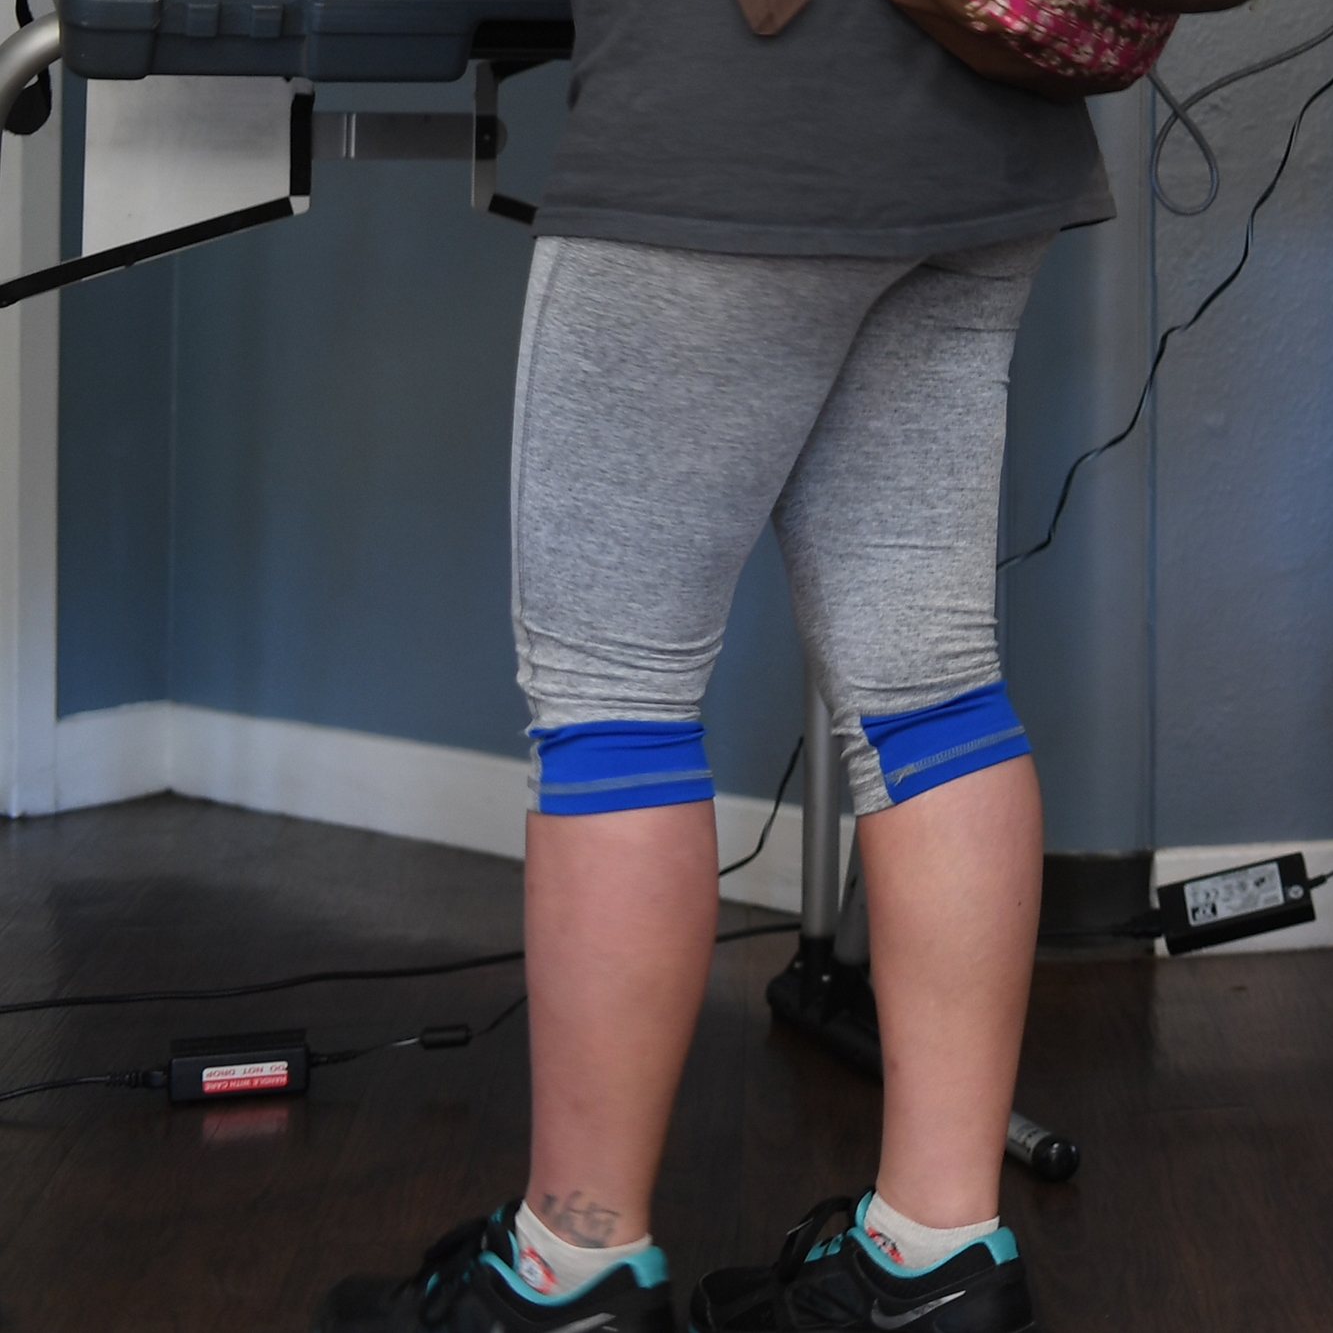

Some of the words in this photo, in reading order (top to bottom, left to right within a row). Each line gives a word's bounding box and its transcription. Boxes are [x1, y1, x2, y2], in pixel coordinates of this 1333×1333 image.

[242, 1065, 264, 1076] NOT
[269, 1063, 286, 1072] DO
[205, 1068, 236, 1079] DROP
